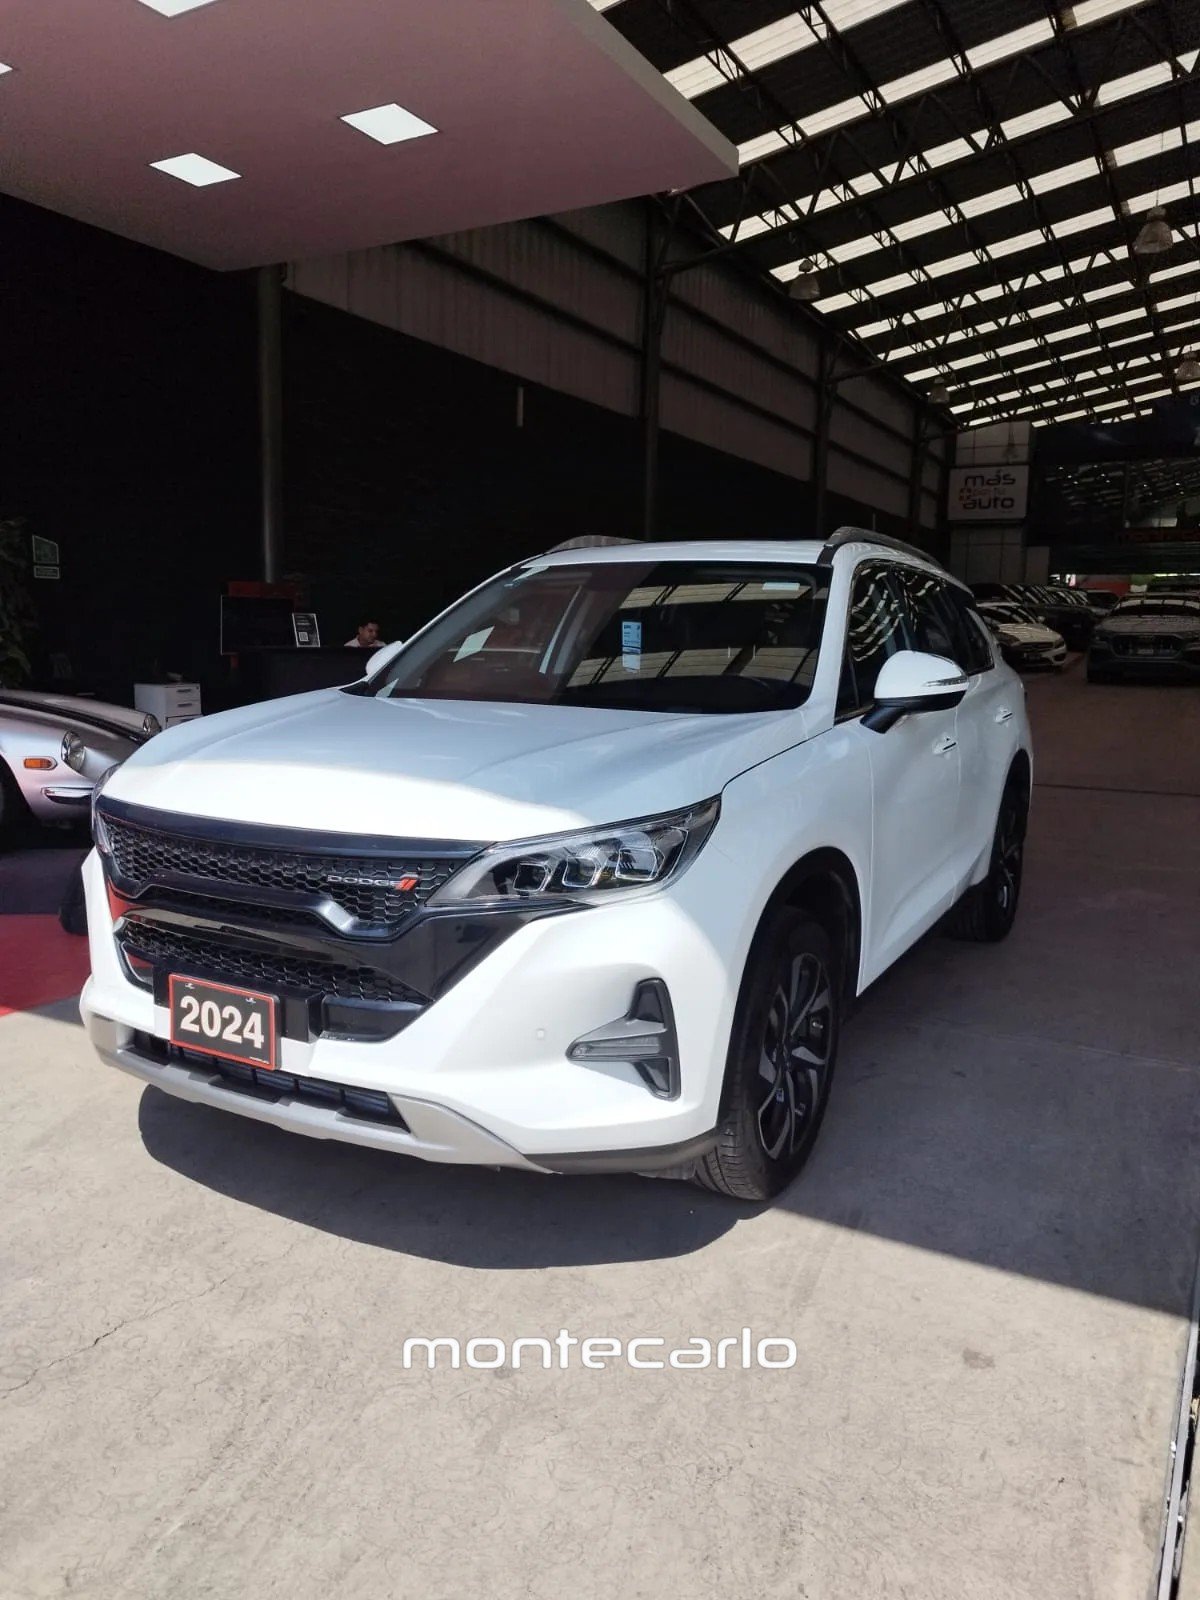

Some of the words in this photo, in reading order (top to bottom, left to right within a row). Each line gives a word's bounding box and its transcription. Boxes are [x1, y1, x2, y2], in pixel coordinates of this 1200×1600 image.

[963, 496, 1015, 509] auto
[327, 874, 401, 888] DODGE
[180, 995, 265, 1049] 2024
